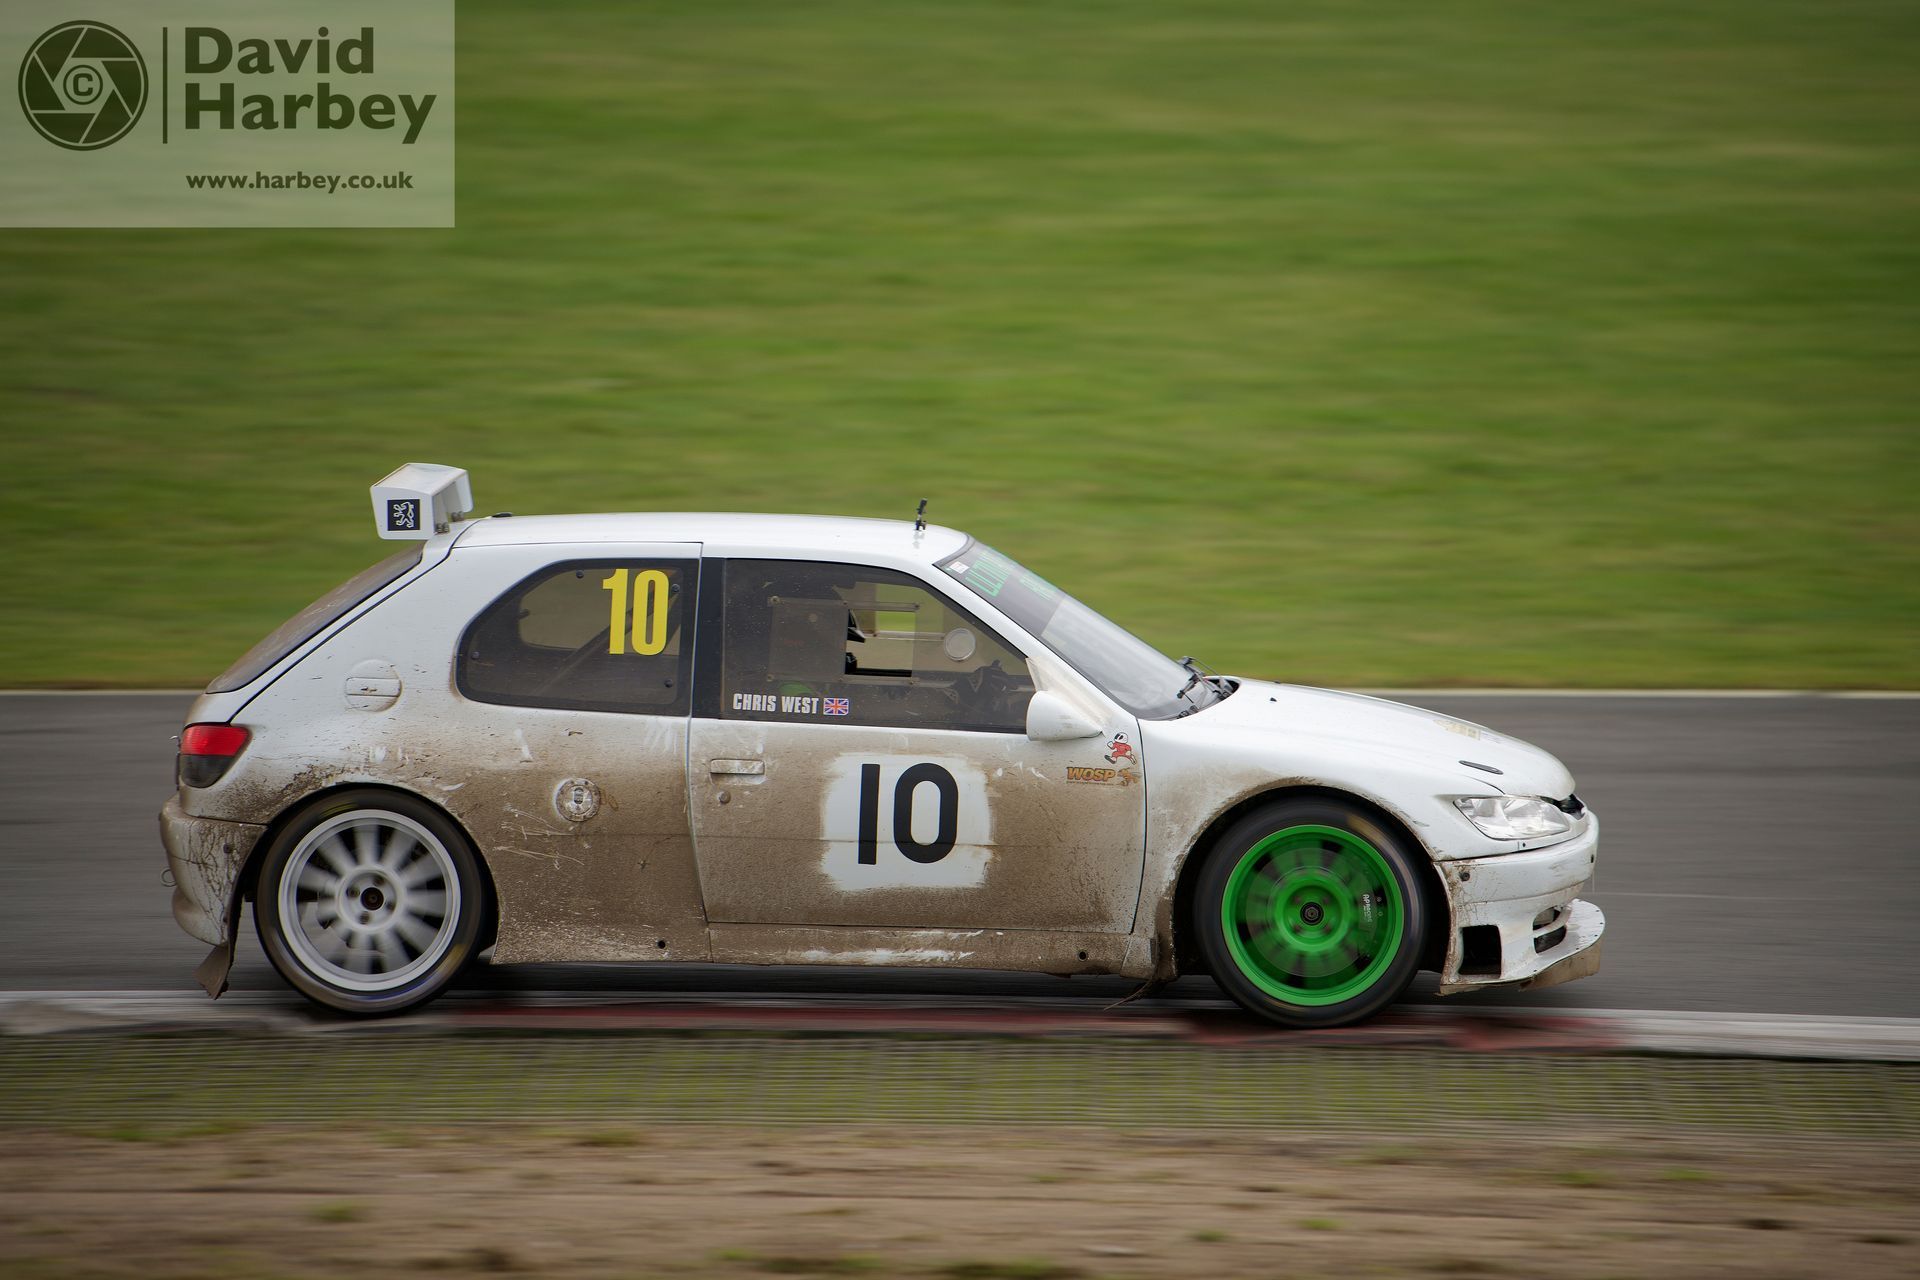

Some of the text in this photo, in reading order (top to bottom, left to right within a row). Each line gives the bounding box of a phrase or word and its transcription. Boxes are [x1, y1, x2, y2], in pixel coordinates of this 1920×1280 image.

[602, 568, 669, 656] 10
[732, 693, 819, 714] CHRIS WEST
[1066, 766, 1116, 781] WOSP
[857, 762, 959, 865] 10
